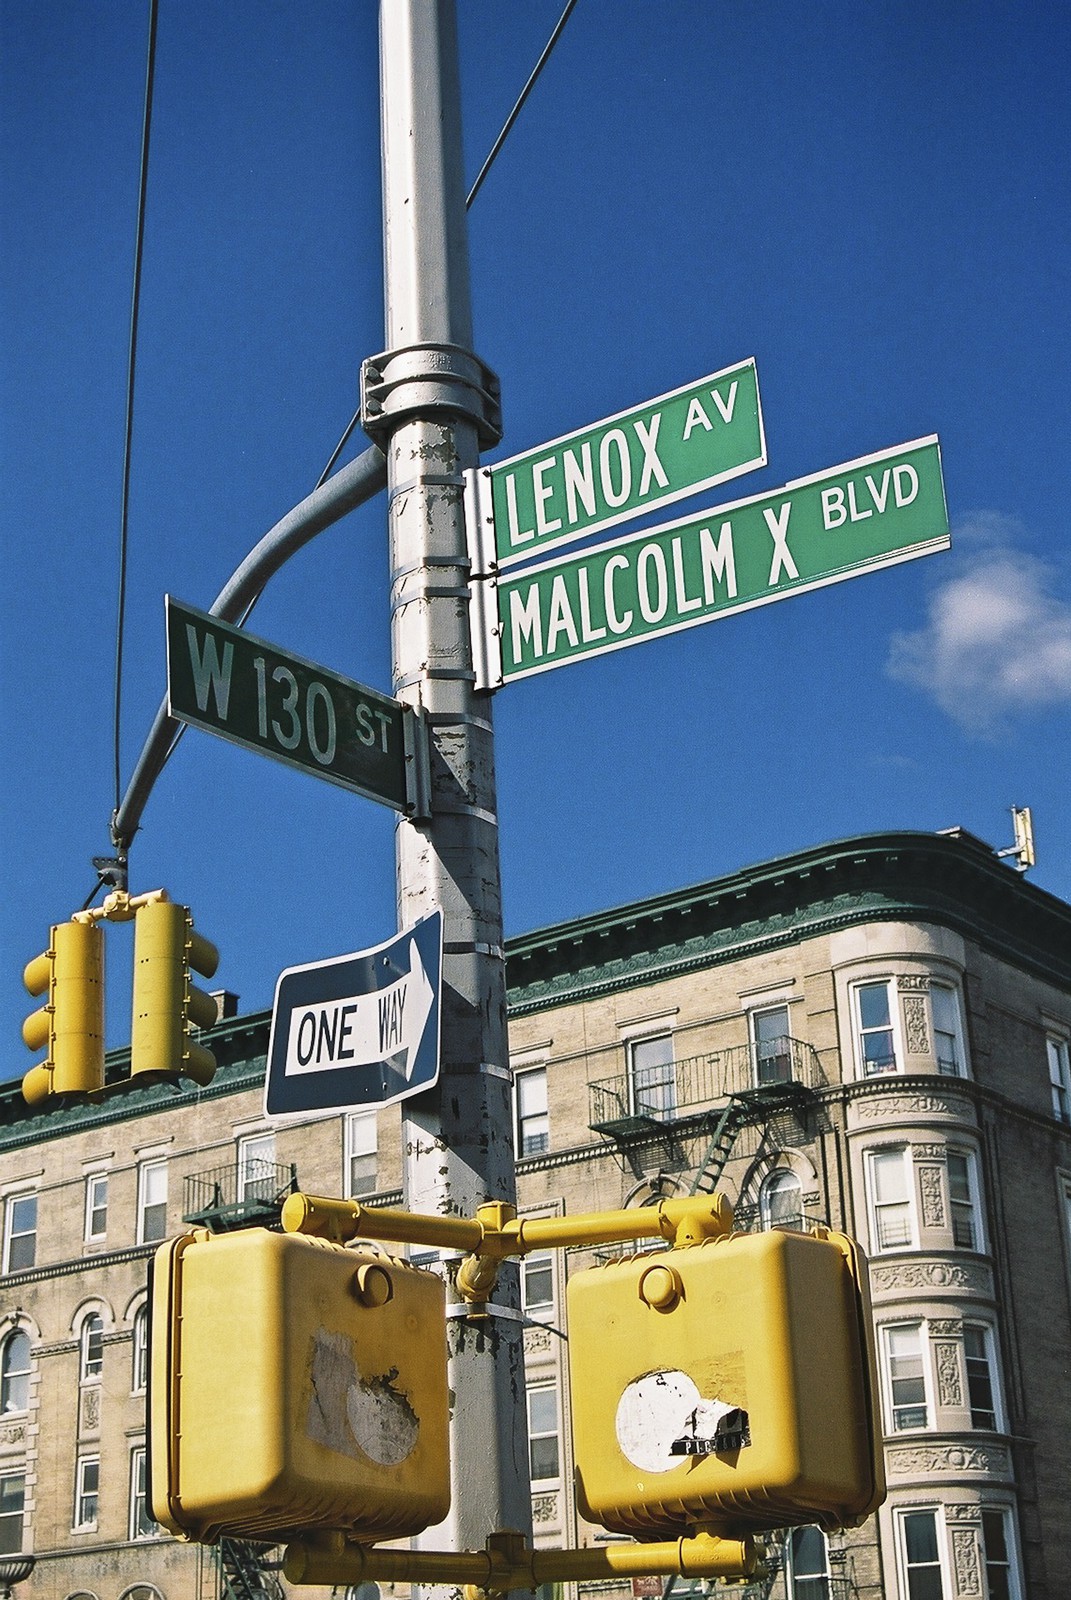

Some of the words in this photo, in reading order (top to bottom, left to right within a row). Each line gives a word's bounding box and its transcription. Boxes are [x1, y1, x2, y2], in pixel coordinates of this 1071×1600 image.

[507, 414, 669, 546] LENOX
[683, 380, 738, 441] AV
[509, 521, 738, 664] MALCOLM
[763, 501, 799, 585] X
[820, 464, 919, 530] BLVD
[186, 623, 234, 721] W
[254, 656, 336, 765] 130
[356, 703, 392, 753] ST
[297, 1004, 357, 1066] ONE
[378, 984, 407, 1053] WAY
